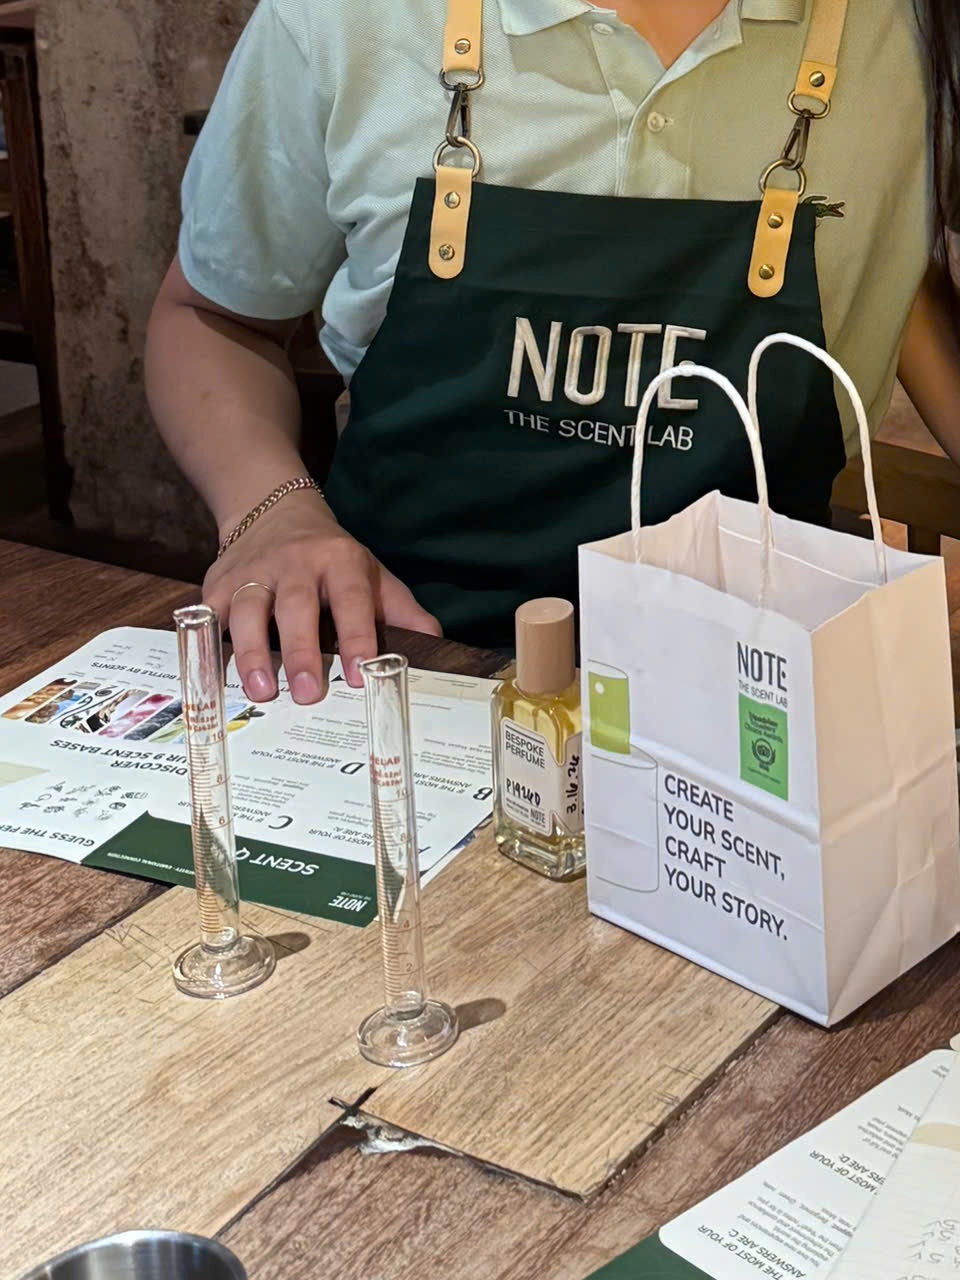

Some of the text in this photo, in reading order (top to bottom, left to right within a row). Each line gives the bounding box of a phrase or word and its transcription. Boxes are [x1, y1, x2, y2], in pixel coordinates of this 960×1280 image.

[507, 317, 706, 410] NOTE
[504, 409, 693, 451] THE SCENT LAB
[91, 662, 177, 681] BOTTLE BY SCENTS
[737, 641, 787, 692] NOTE
[739, 679, 788, 709] THE SCENT LAB
[213, 731, 224, 741] 10
[505, 730, 544, 757] BESPOKE
[50, 739, 186, 764] UR 9 SCENT BASES
[250, 750, 273, 759] YOUR
[300, 752, 342, 764] ANSWERS
[505, 741, 545, 769] PERFUME
[110, 760, 188, 776] DISCOVER
[286, 756, 310, 764] MOST
[311, 759, 327, 767] THE
[340, 762, 365, 775] D
[217, 774, 223, 783] 8
[415, 780, 439, 788] MOST
[429, 776, 472, 789] ANSWERS
[473, 787, 493, 801] B
[664, 774, 733, 822] CREATE
[268, 816, 293, 830] C
[20, 827, 48, 838] THE
[49, 831, 95, 847] GUESS
[308, 829, 331, 838] YOUR
[333, 833, 346, 841] OF
[342, 828, 361, 836] ARE
[347, 836, 373, 846] MOST
[664, 803, 785, 881] YOUR SCENT,
[249, 853, 319, 875] SCENT
[665, 837, 726, 878] CRAFT
[328, 895, 367, 912] NOTE
[664, 864, 787, 940] YOUR STORY.
[810, 1150, 837, 1170] YOUR
[850, 1159, 870, 1174] ARE
[834, 1165, 850, 1177] OF
[847, 1173, 878, 1193] MOST
[736, 1234, 759, 1250] ARE
[698, 1225, 784, 1280] THE MOST OF YOUR
[755, 1243, 806, 1279] ANSWERS
